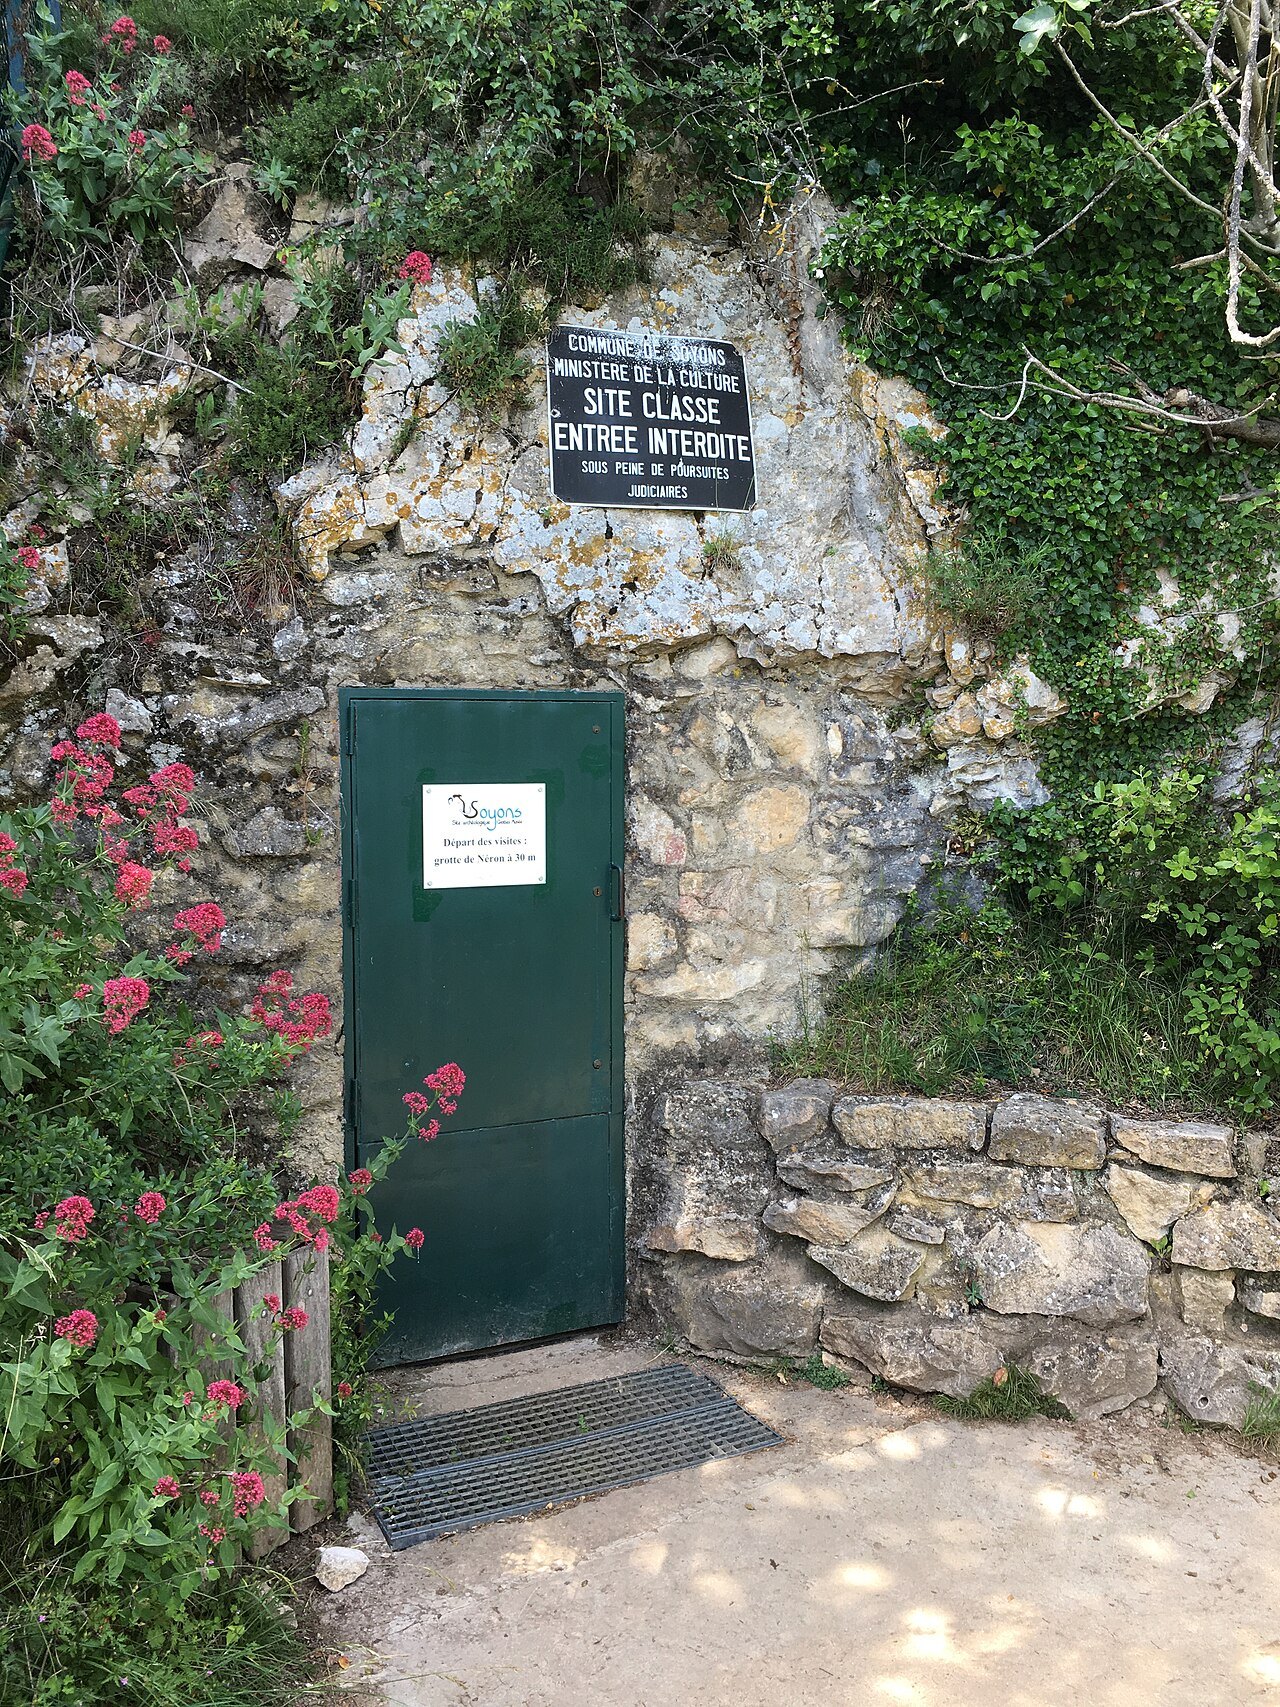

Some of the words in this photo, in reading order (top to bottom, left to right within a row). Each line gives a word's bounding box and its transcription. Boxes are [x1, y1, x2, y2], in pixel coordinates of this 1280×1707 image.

[568, 334, 634, 358] COMMUNE
[643, 343, 663, 360] DE
[671, 345, 726, 366] SOYONS
[554, 358, 630, 382] MINISTERE
[634, 365, 653, 384] DE
[657, 366, 676, 387] LA
[680, 369, 741, 394] CULTURE
[583, 387, 633, 417] SITE
[642, 392, 721, 425] CLASSE
[554, 423, 638, 453] ENTREE
[648, 427, 751, 462] INTERDITE
[581, 460, 608, 474] SOUS
[615, 462, 645, 476] PEINE
[651, 463, 665, 476] DE
[670, 465, 730, 480] POURSUITES
[627, 484, 688, 499] JUDICIAIRES
[443, 838, 475, 848] Départ
[477, 837, 492, 846] des
[495, 836, 522, 846] visites
[434, 857, 462, 867] grotte
[464, 855, 475, 864] de
[477, 854, 505, 863] Néron
[507, 853, 513, 862] à
[515, 853, 526, 862] 30
